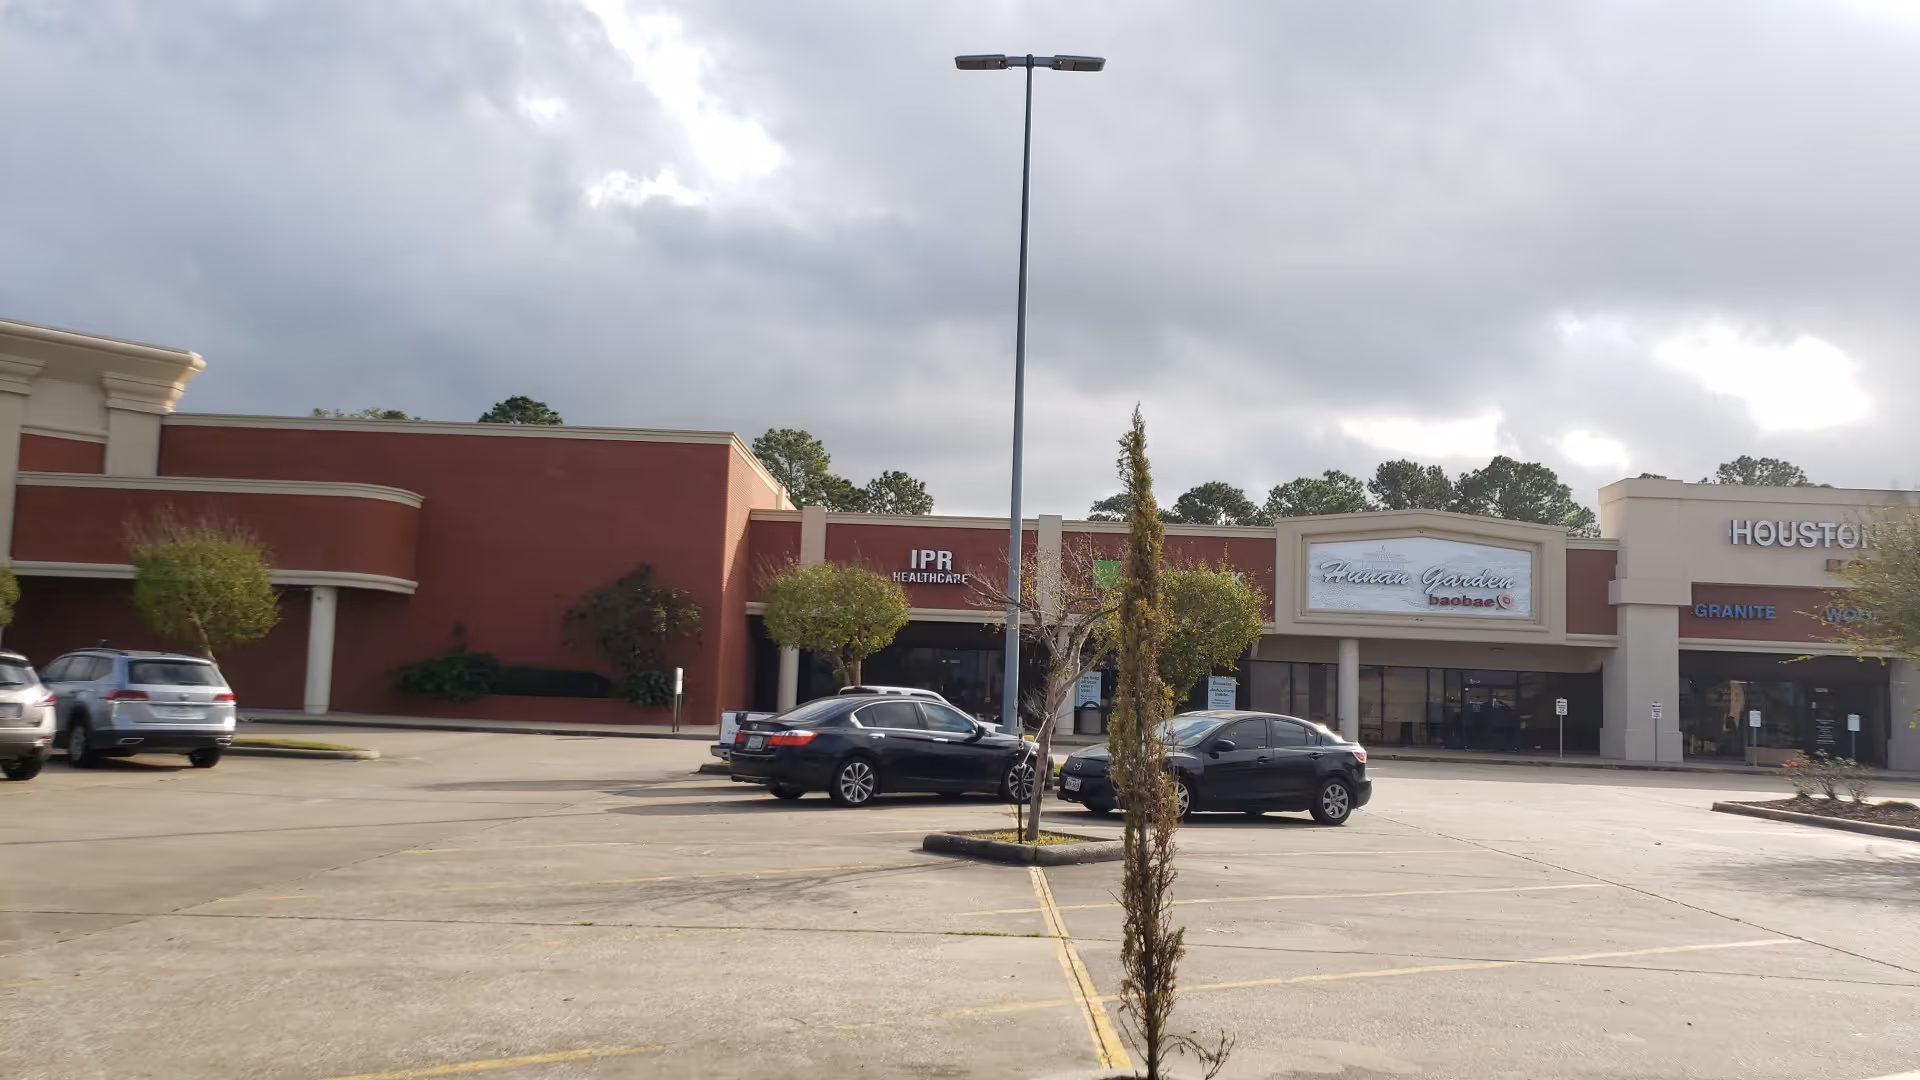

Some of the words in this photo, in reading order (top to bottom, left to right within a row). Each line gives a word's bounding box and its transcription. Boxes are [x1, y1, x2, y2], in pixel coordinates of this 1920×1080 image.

[911, 549, 953, 571] IPR
[893, 571, 969, 584] HEALTHCARE
[1320, 559, 1410, 585] Hunan
[1421, 565, 1515, 594] Garden
[1695, 602, 1777, 619] GRANITE
